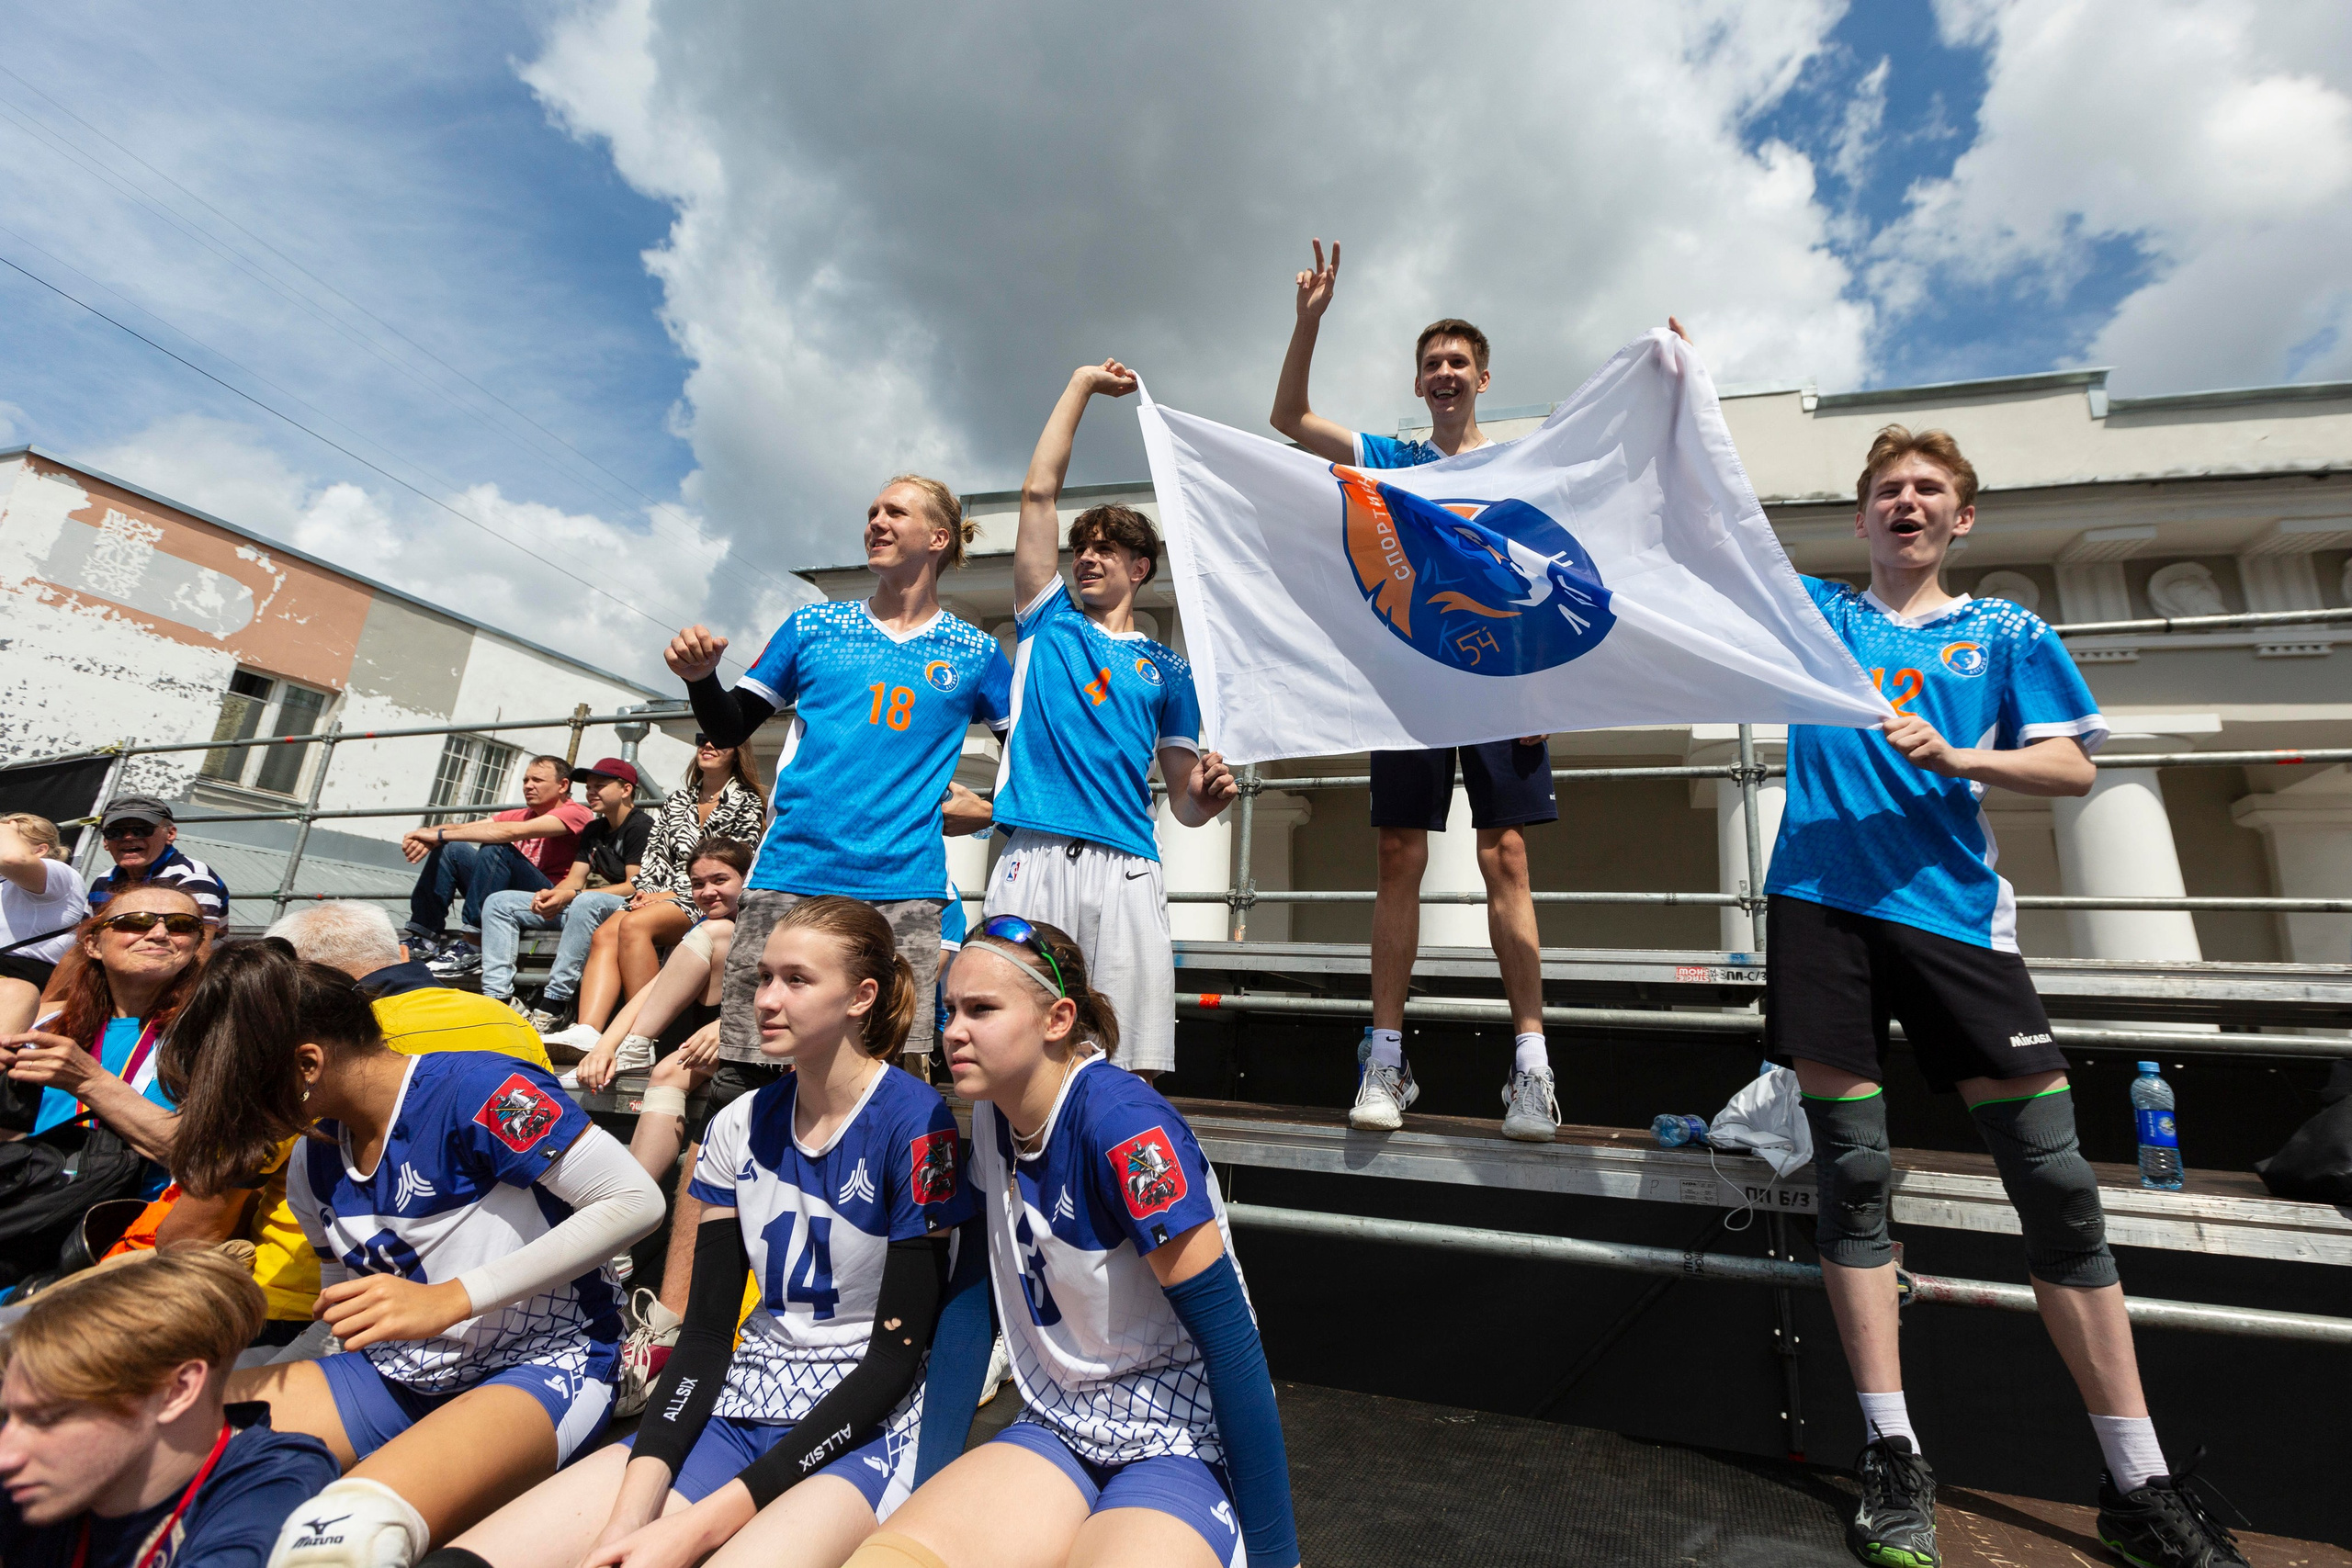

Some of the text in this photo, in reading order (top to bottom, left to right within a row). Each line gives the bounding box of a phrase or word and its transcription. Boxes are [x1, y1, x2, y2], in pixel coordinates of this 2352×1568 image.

[869, 682, 916, 731] 18
[1083, 666, 1113, 706] 4
[1869, 667, 1925, 717] 12
[760, 1210, 841, 1321] 14
[662, 1376, 699, 1422] ALLSIX
[798, 1423, 852, 1472] ALLSIX
